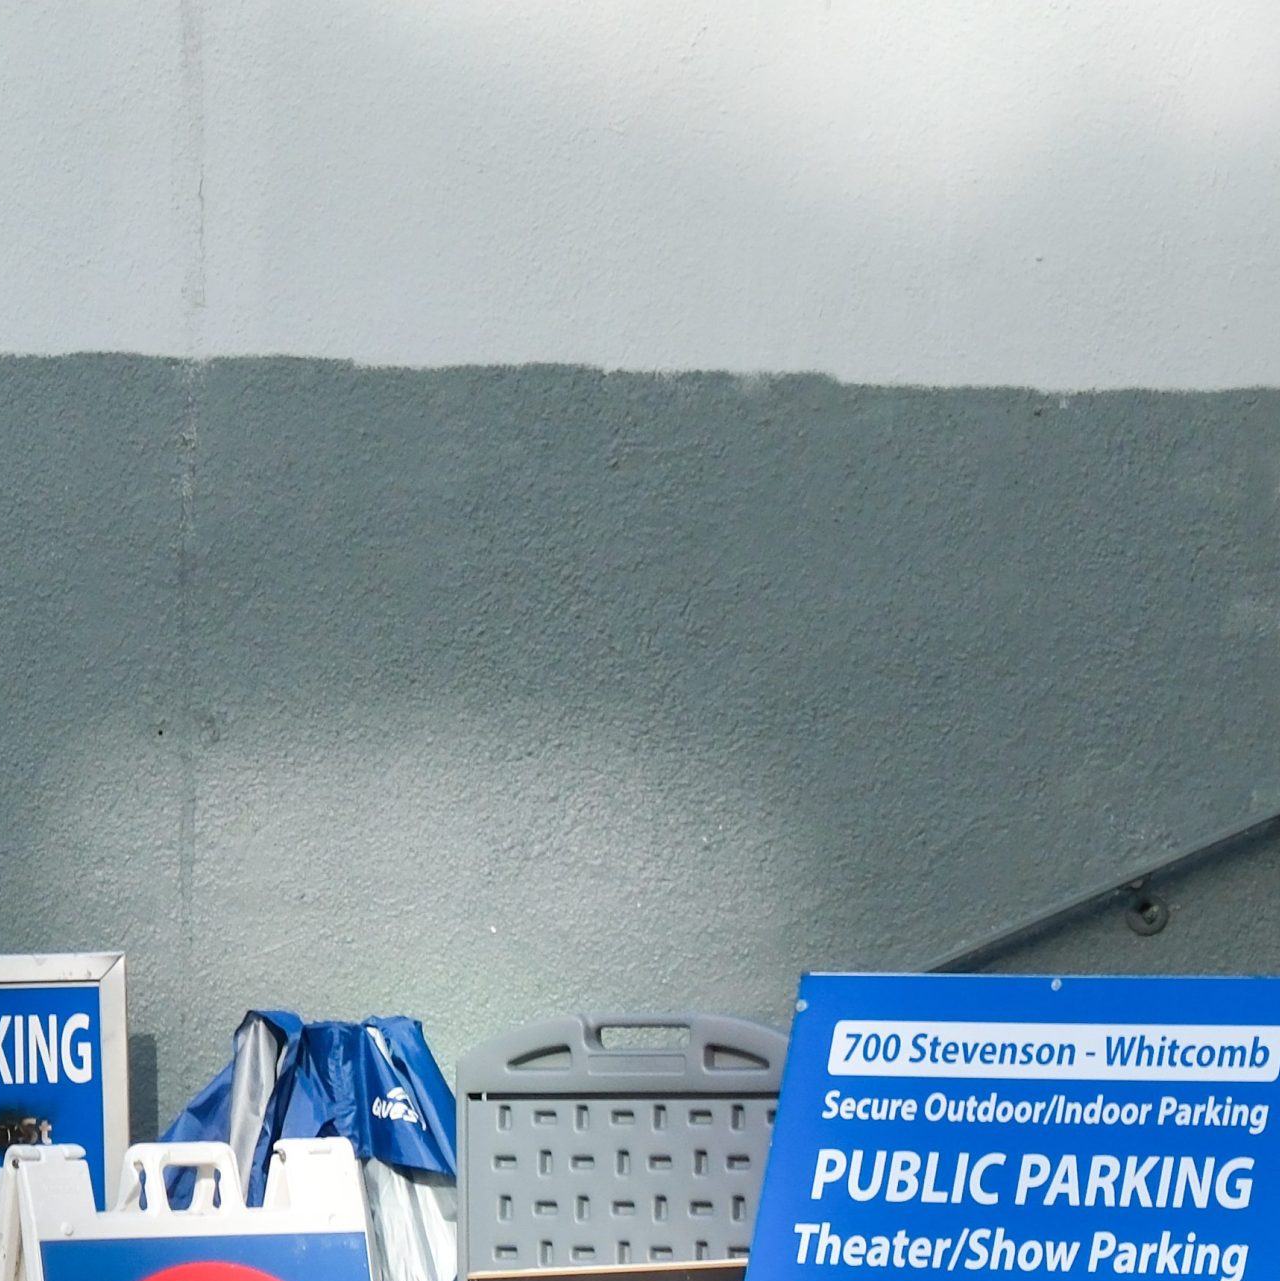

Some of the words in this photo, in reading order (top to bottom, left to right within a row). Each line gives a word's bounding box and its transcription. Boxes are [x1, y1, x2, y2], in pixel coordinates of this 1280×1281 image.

[844, 1034, 901, 1062] 700
[909, 1033, 1075, 1065] Stevenson
[1106, 1035, 1269, 1068] Whitcomb
[822, 1090, 917, 1120] Secure
[925, 1093, 1152, 1125] Outdoor/Indoor
[1158, 1096, 1269, 1134] Parking
[811, 1149, 1006, 1204] PUBLIC
[1015, 1154, 1254, 1209] PARKING
[794, 1222, 1080, 1271] Theater/Show
